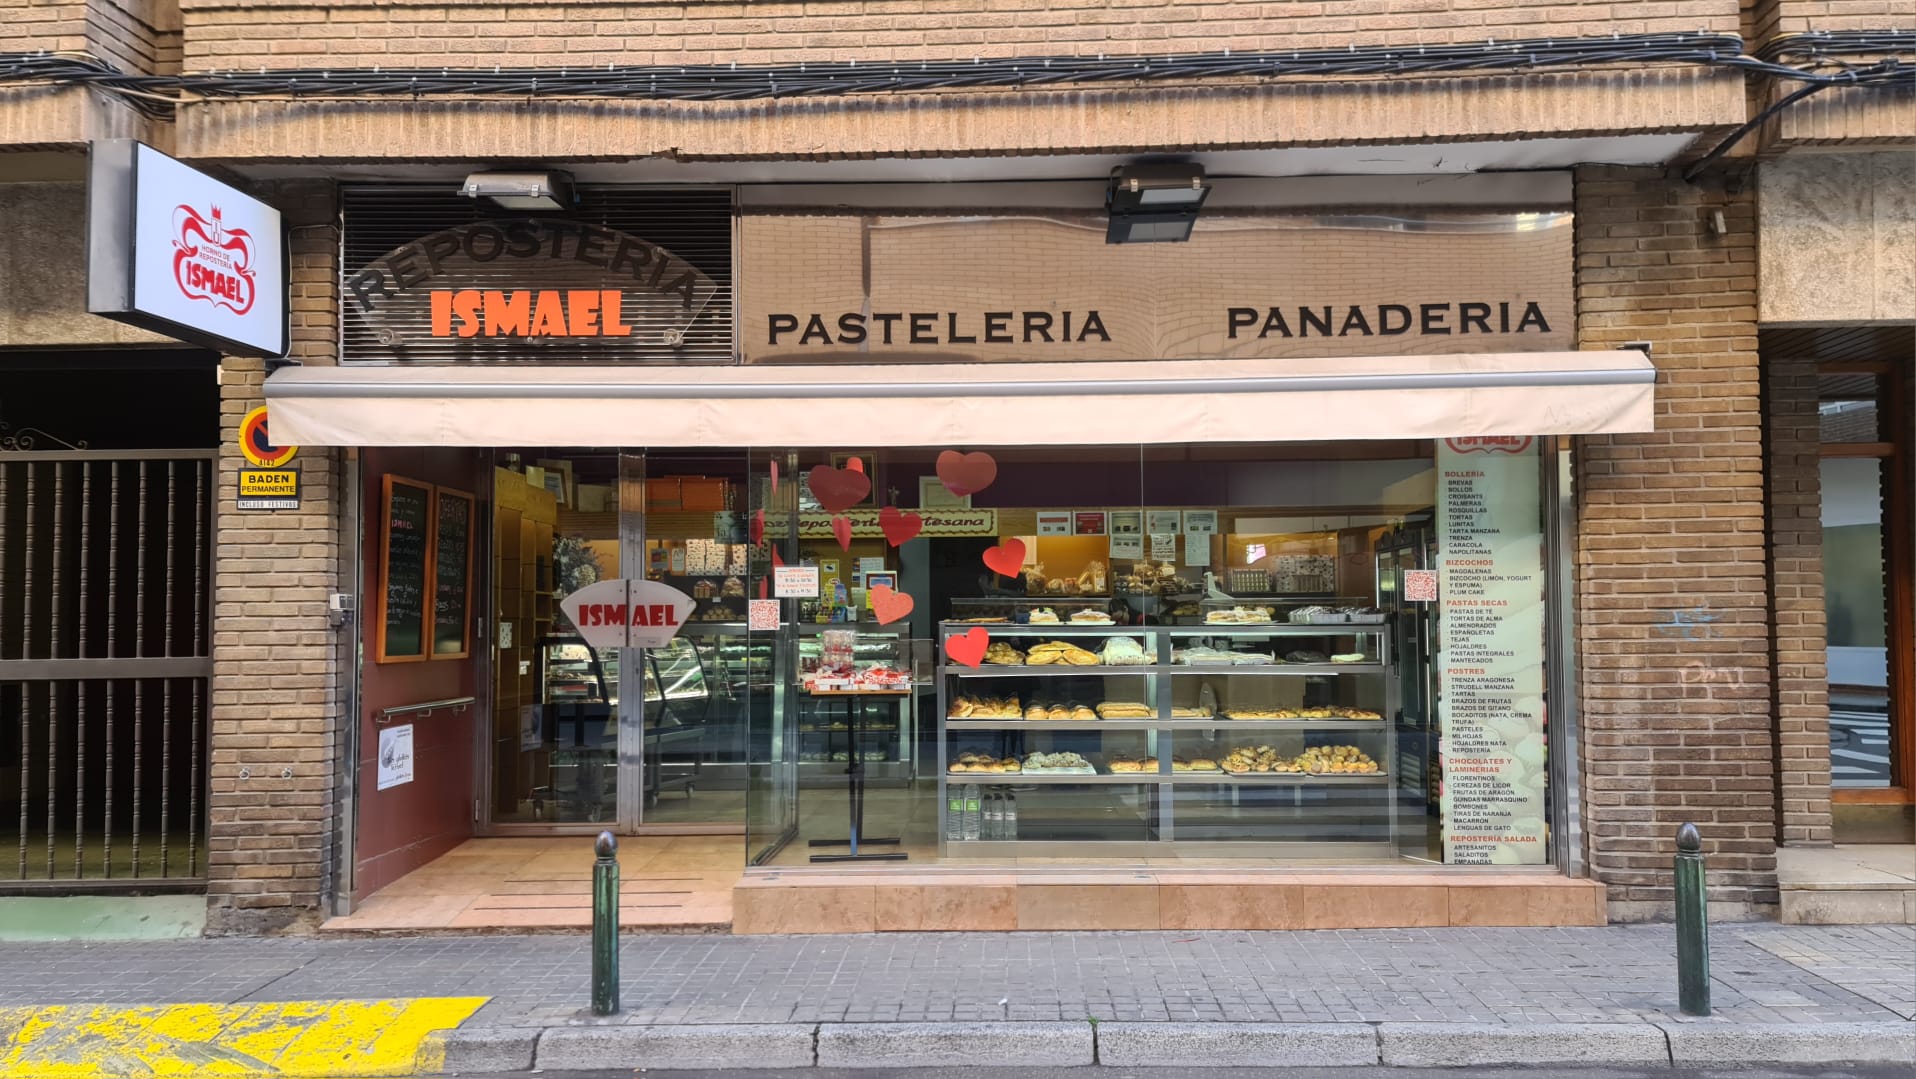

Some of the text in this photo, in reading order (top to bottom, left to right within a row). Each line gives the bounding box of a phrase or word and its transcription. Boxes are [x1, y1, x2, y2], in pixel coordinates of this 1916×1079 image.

[202, 245, 231, 261] HORNO DE
[350, 221, 698, 313] REPOSTERIA
[186, 261, 244, 304] ISMAEL
[431, 290, 632, 337] ISMAEL
[767, 310, 1112, 345] PASTELERIA
[1227, 301, 1552, 339] PANADERIA
[242, 485, 296, 493] PERMANENTE
[249, 475, 289, 483] BADEN
[578, 603, 679, 627] ISMAEL
